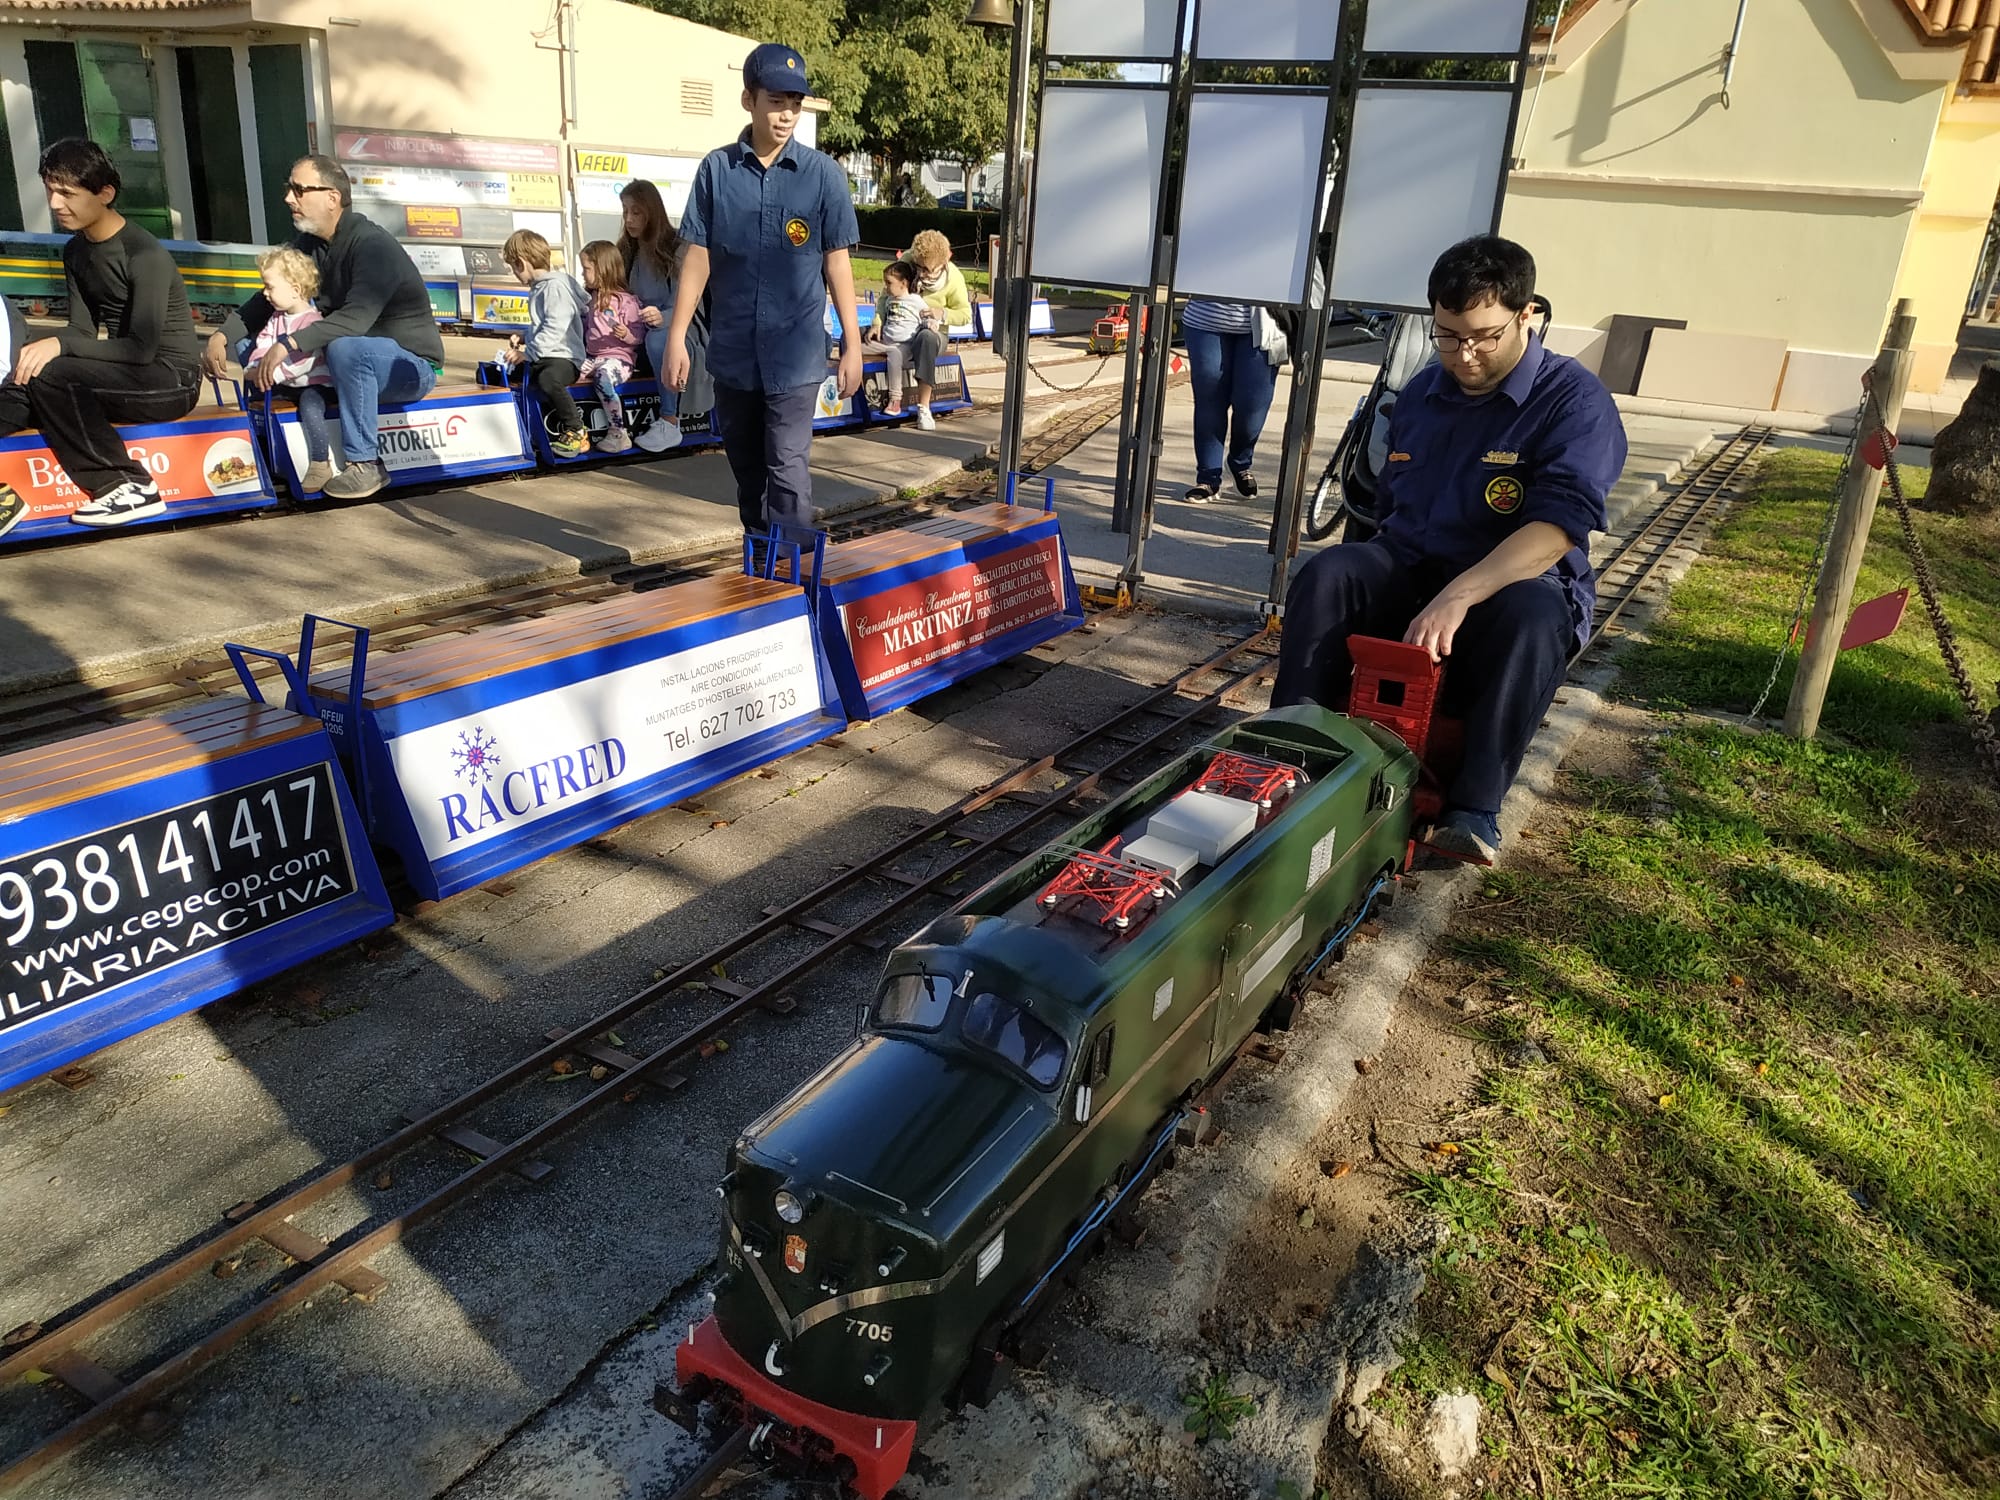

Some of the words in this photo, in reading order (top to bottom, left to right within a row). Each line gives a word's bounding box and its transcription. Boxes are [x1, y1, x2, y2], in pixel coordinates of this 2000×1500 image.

[384, 139, 444, 154] INMOLLAR
[582, 155, 625, 173] AFEVI
[511, 173, 554, 184] LITUSA
[973, 563, 1010, 587] ESPECIALITAT
[1010, 561, 1018, 572] EN
[1018, 556, 1034, 570] CARN
[1034, 549, 1053, 565] FRESCA
[975, 591, 984, 604] DE
[984, 585, 999, 601] PORC
[1020, 573, 1031, 586] DEL
[976, 603, 1000, 621] PERNILS
[1003, 588, 1030, 610] EMBOTITS
[1029, 580, 1056, 599] CASOLANS
[882, 600, 975, 657] MARTINEZ
[726, 641, 784, 667] FRIGORIFIQUES
[895, 662, 911, 676] DESDE
[691, 680, 710, 695] AIRE
[710, 663, 763, 688] CONDICIONAT
[645, 700, 697, 726] MUNTATGES
[697, 680, 754, 709] D'HOSTELERIA
[664, 726, 696, 752] Tel.
[700, 711, 729, 739] 627
[735, 699, 765, 726] 702
[768, 688, 796, 714] 733
[438, 737, 627, 843] RACFRED
[0, 775, 317, 947] 938141417
[11, 847, 331, 977] www.cegecop.com
[185, 873, 343, 948] ACTIVA
[844, 1317, 894, 1343] 7705
